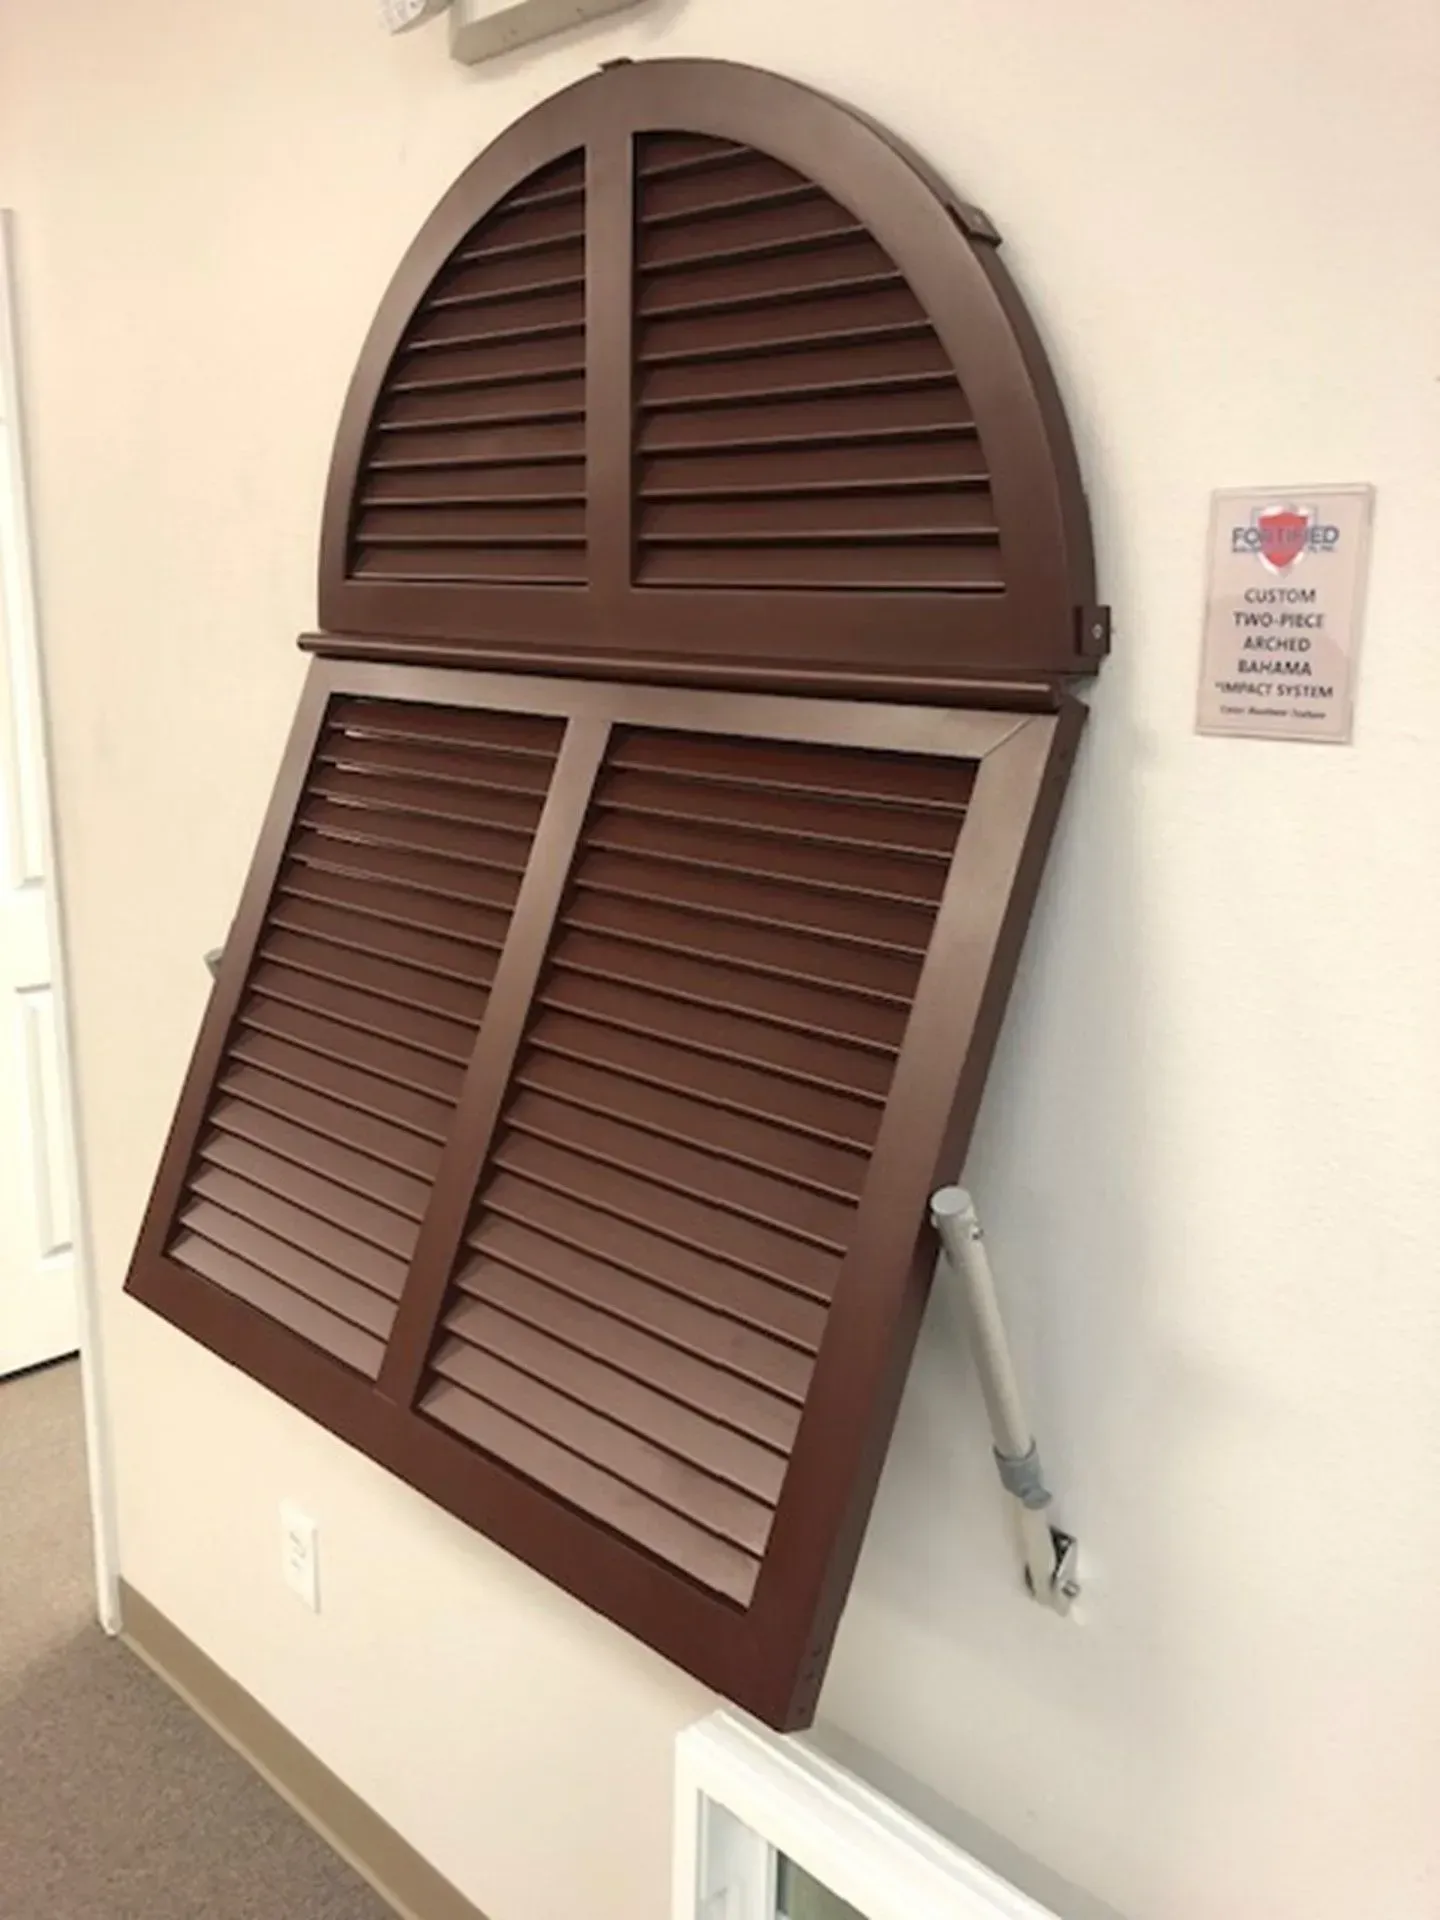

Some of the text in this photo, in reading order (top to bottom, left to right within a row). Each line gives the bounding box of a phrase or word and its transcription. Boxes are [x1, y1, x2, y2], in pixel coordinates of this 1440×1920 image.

[1243, 588, 1316, 604] CUSTOM
[1233, 611, 1324, 628] TWO-PIECE
[1243, 636, 1311, 652] ARCHED
[1237, 659, 1312, 676] BAHAMA
[1277, 684, 1333, 698] SYSTEM
